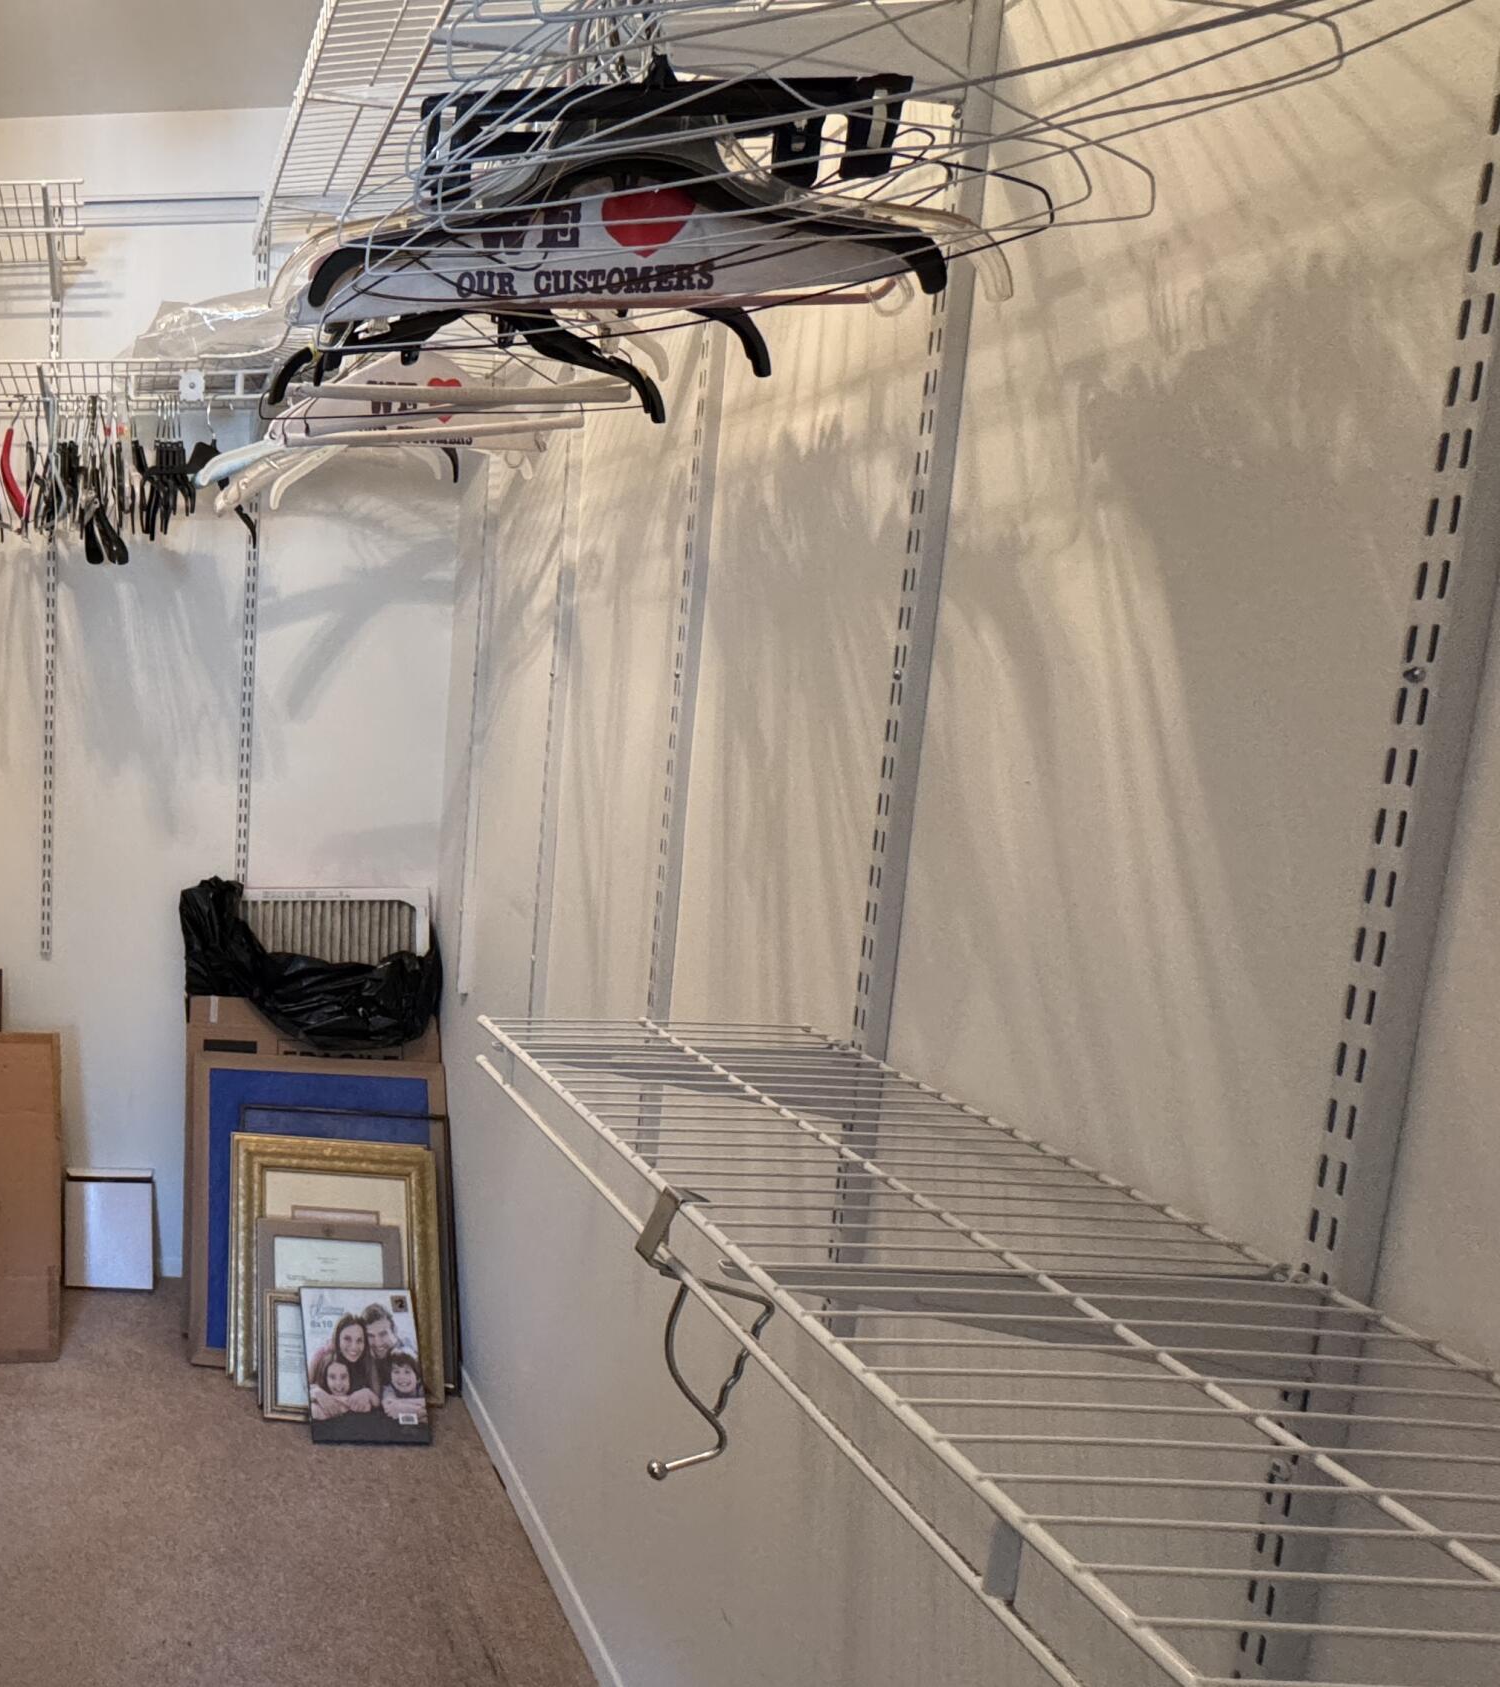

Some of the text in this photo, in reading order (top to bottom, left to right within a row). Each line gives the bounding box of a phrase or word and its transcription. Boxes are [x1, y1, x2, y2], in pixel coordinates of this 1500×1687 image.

[479, 202, 582, 255] WE
[456, 262, 715, 298] OUR CUSTOMERS
